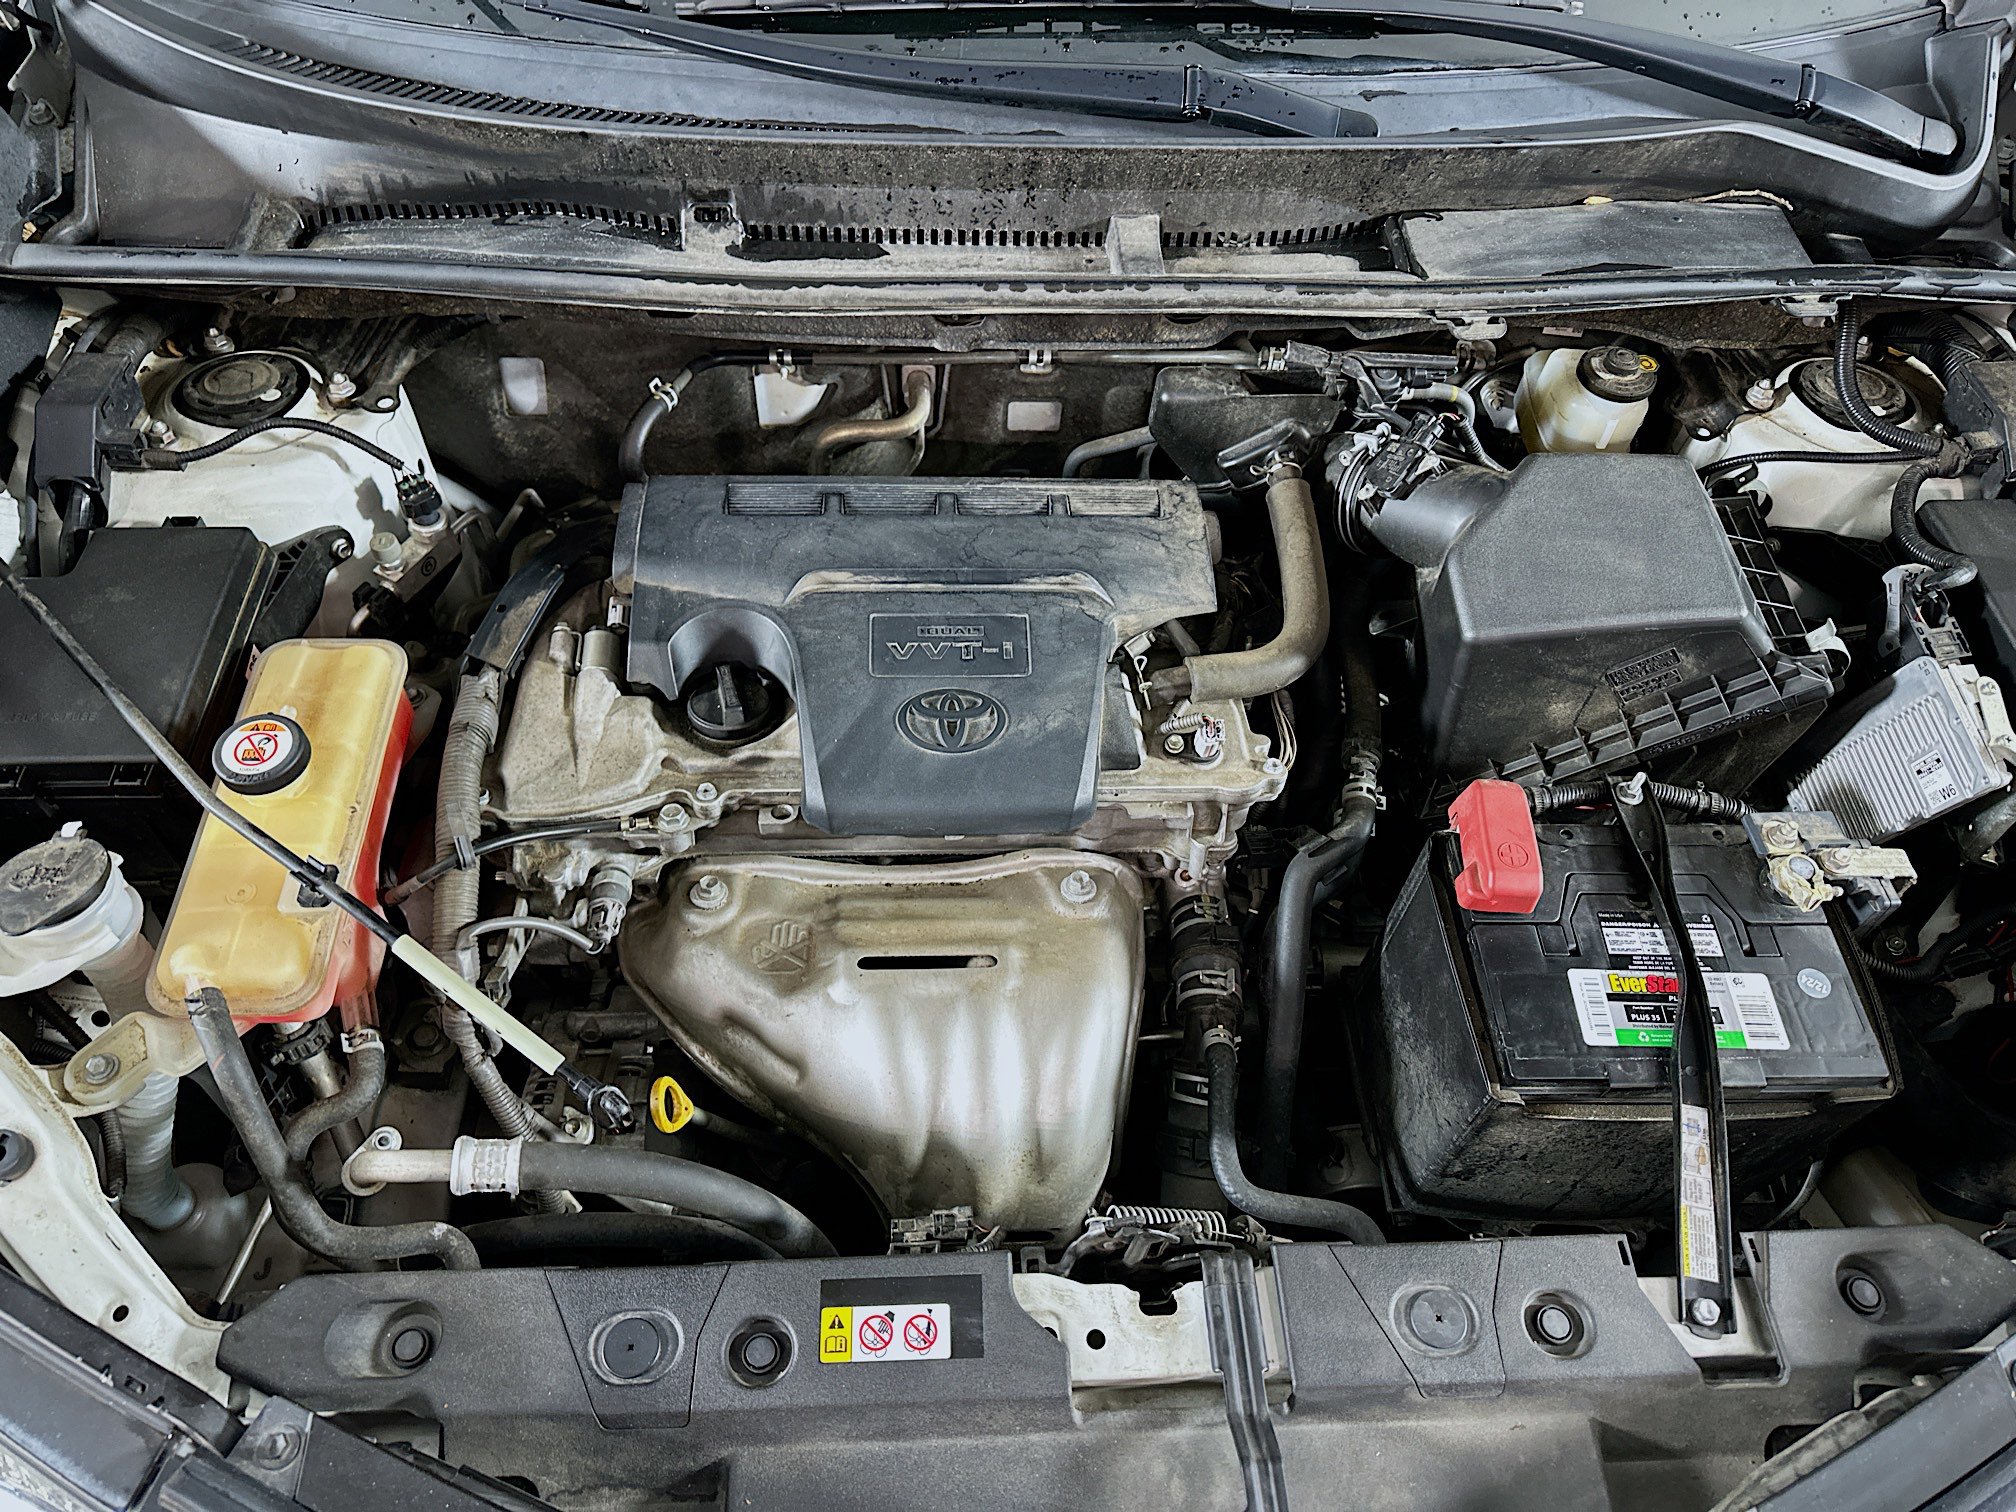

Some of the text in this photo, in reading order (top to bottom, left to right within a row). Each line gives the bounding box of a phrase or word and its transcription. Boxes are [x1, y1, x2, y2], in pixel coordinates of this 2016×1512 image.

[925, 626, 980, 637] DUAL
[886, 641, 1013, 660] VVT-i
[1938, 783, 1957, 800] W6
[1630, 1013, 1650, 1021] PLUS
